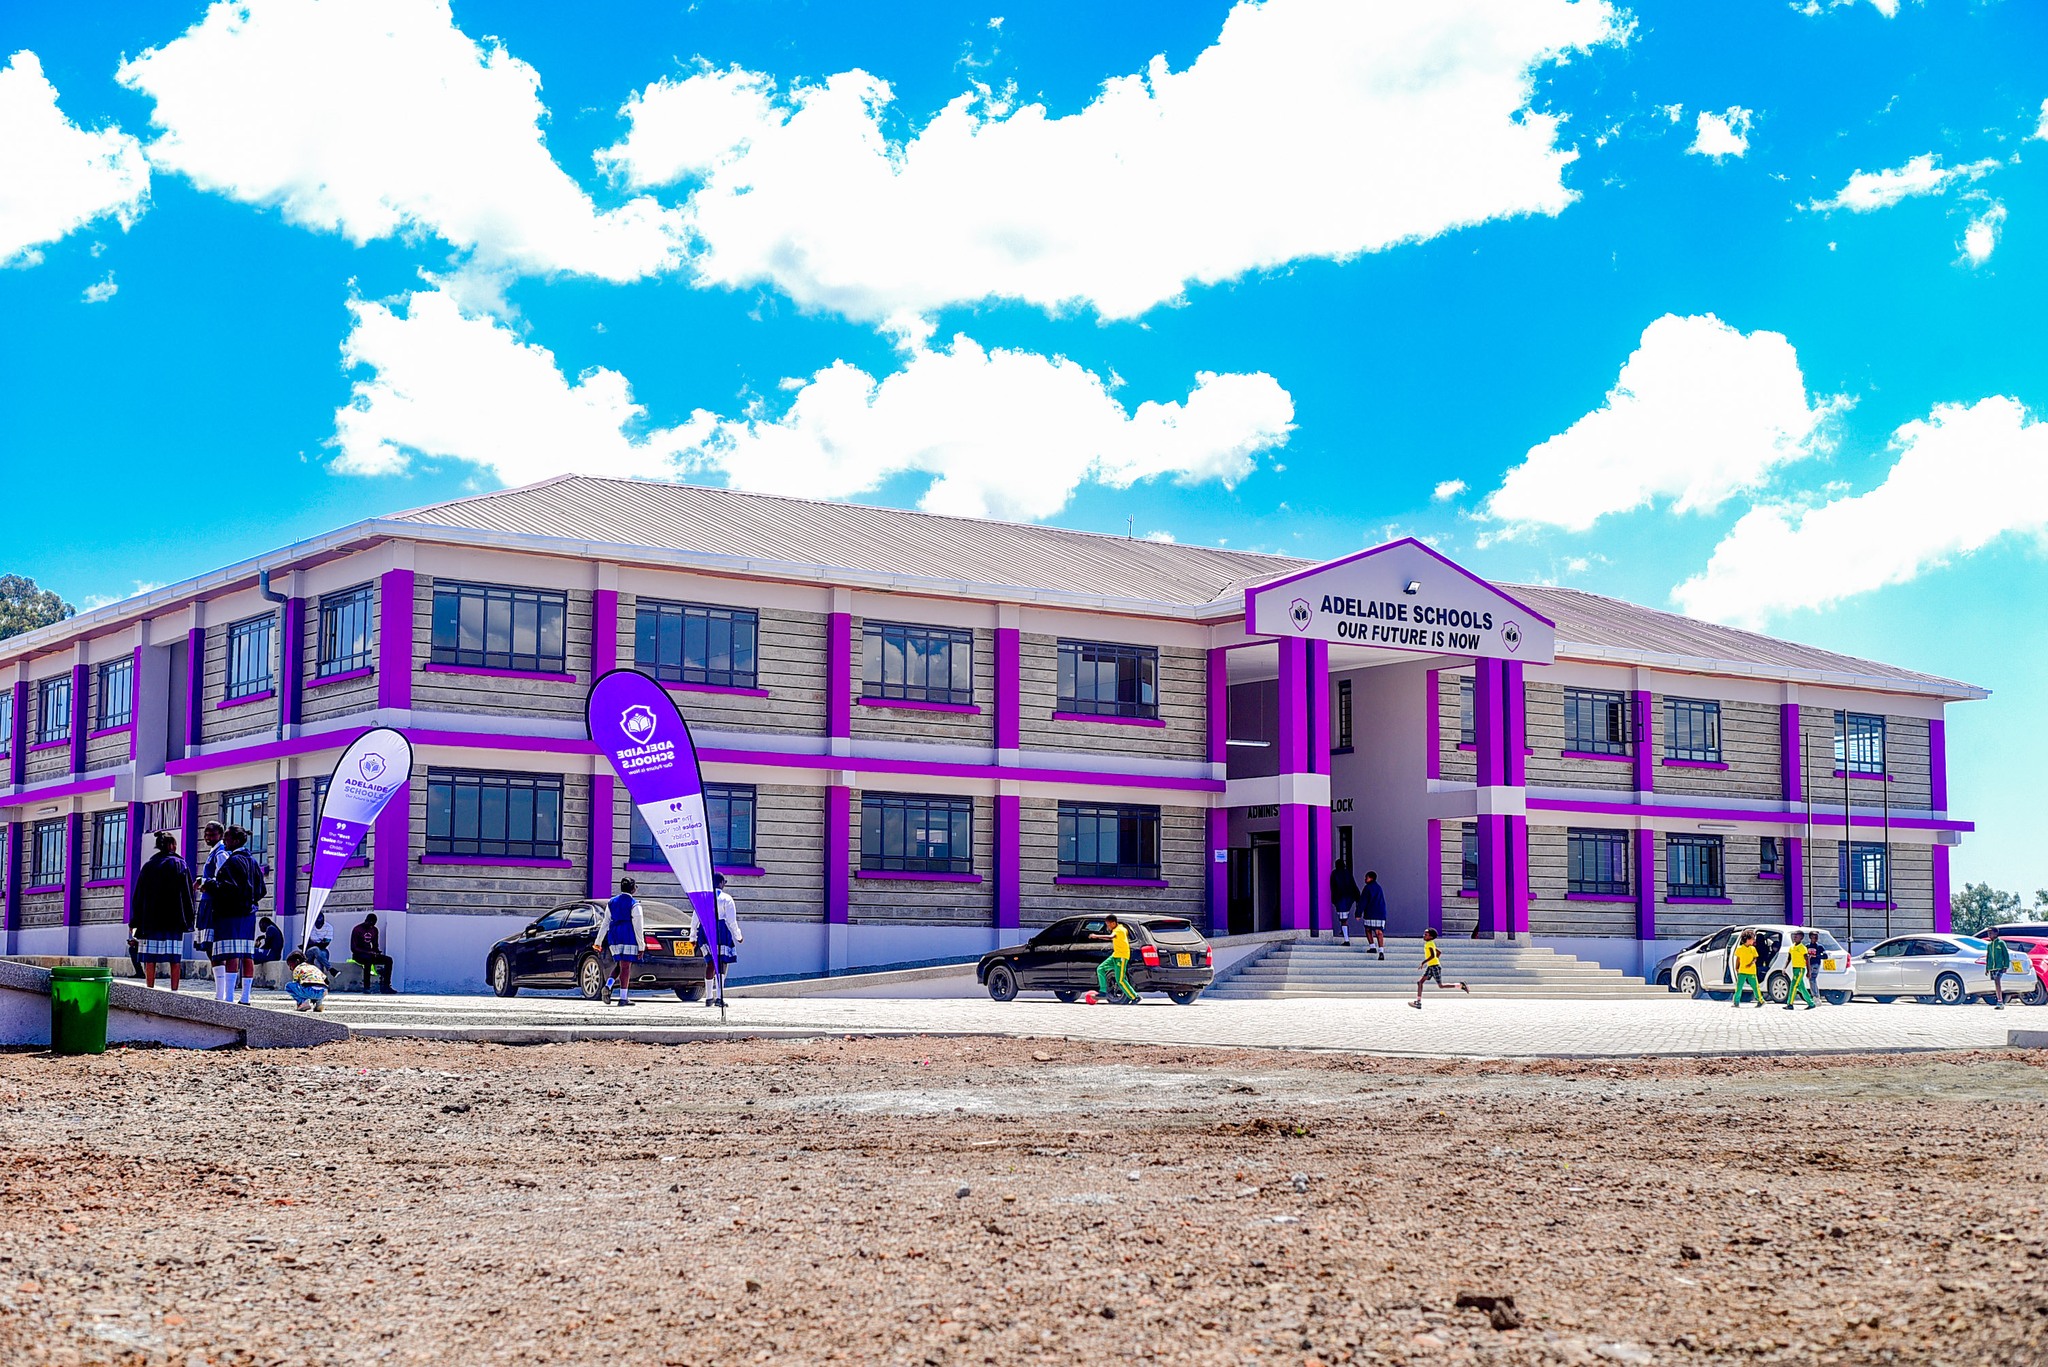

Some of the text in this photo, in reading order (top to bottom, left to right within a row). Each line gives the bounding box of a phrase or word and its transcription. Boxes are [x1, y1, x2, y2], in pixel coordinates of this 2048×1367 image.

[1320, 594, 1493, 630] ADELAIDE SCHOOLS
[1337, 620, 1480, 650] OUR FUTURE IS NOW
[344, 778, 389, 793] ADELAIDE
[344, 785, 384, 800] SCHOOLS
[1247, 798, 1354, 819] ADMINIS LOCK
